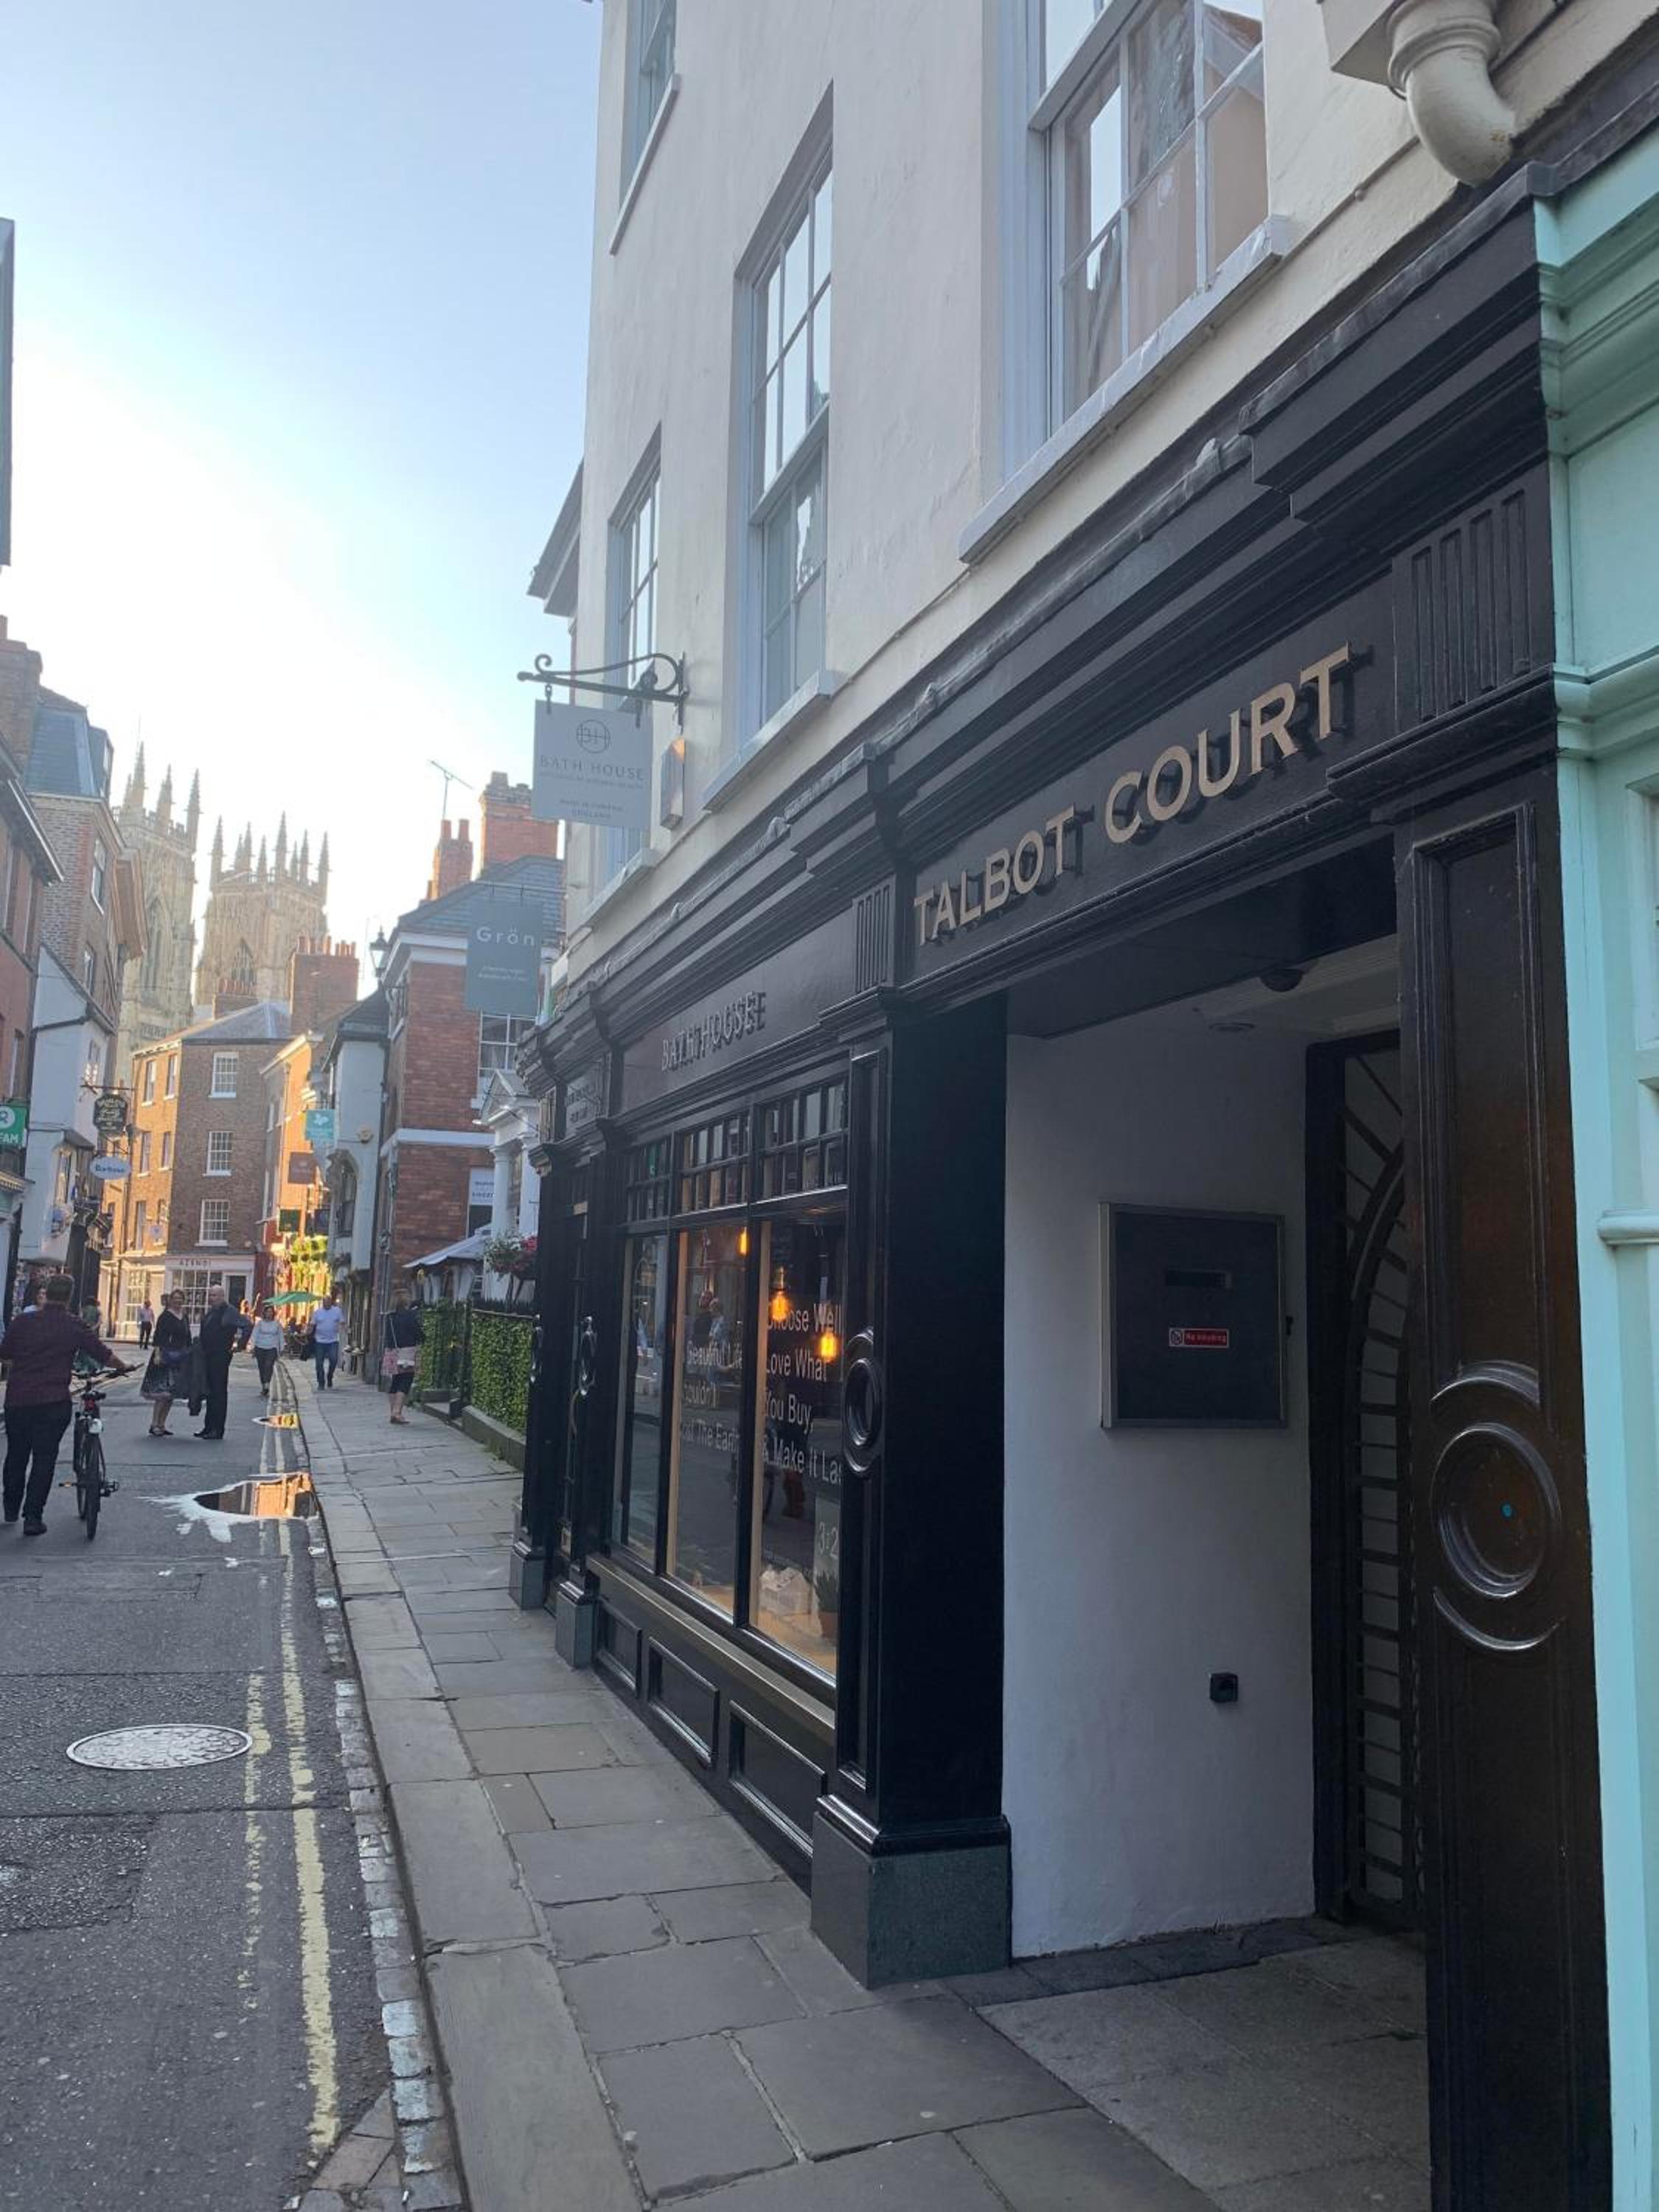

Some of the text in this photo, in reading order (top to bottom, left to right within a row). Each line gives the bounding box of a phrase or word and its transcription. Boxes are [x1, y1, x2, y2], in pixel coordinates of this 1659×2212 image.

[540, 754, 644, 780] BATH HOUSE
[914, 640, 1352, 947] TALBOT COURT
[476, 925, 535, 946] Grön
[767, 1352, 791, 1377] ove
[822, 1450, 841, 1486] La
